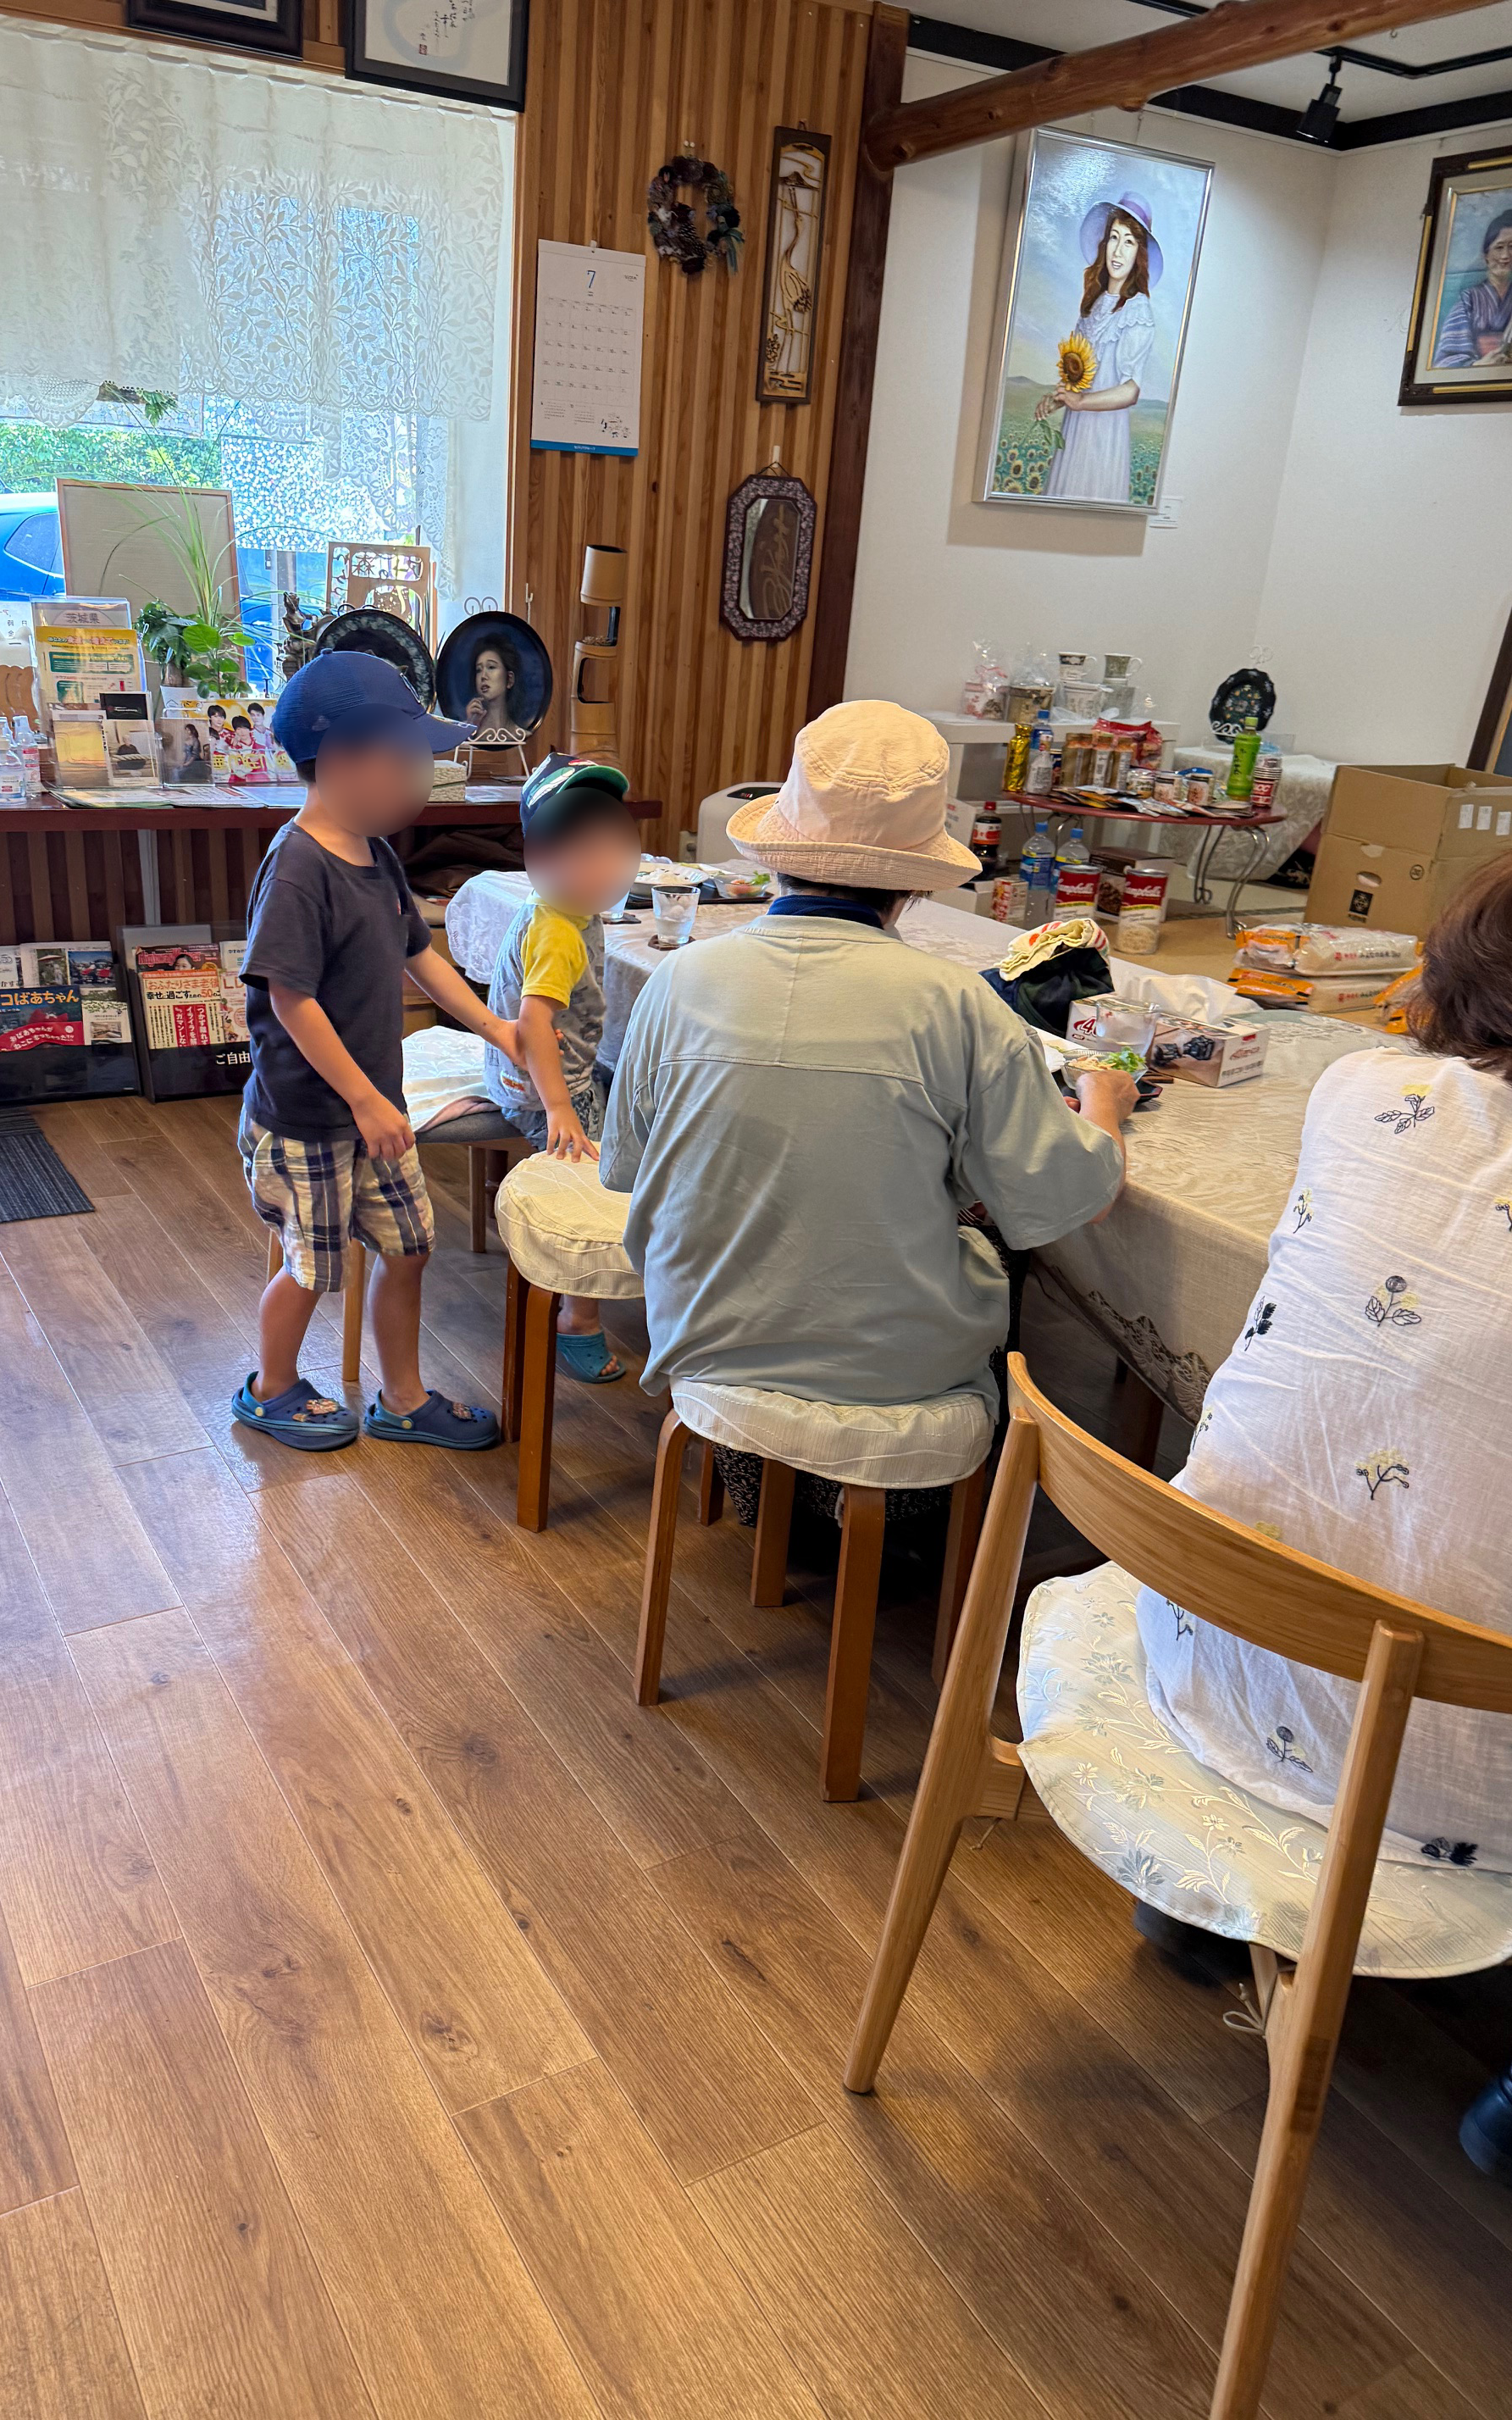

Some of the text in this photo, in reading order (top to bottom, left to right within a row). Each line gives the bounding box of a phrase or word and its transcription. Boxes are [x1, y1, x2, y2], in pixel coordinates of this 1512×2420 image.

[587, 269, 596, 289] 7
[65, 613, 100, 624] 茨城県
[0, 989, 80, 1007] コばあちゃん
[215, 1051, 251, 1065] ご自由
